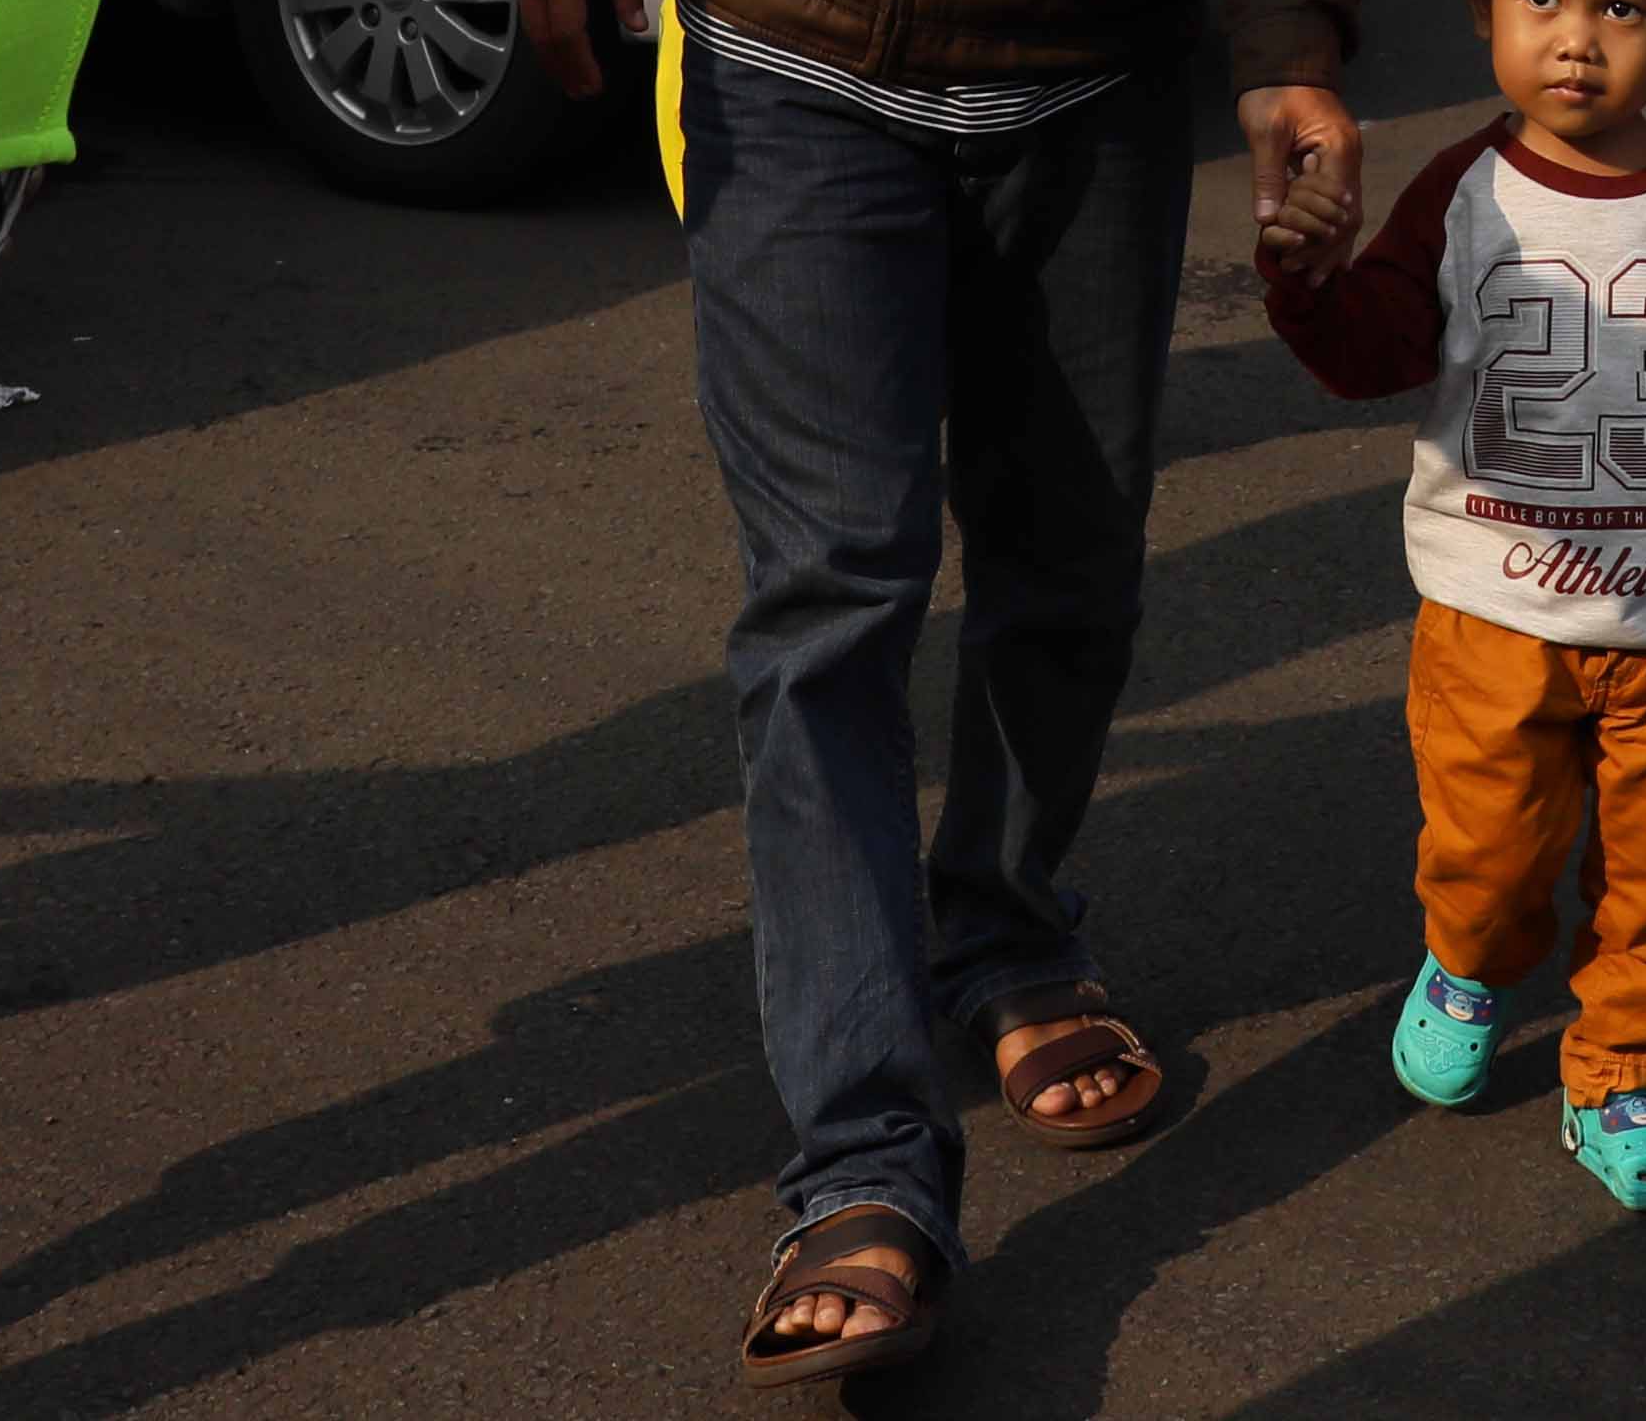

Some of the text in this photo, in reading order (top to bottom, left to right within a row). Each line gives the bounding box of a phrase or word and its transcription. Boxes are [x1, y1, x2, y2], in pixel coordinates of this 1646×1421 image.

[1471, 498, 1528, 522] LITTLE
[1534, 510, 1585, 525] BOYS
[1593, 511, 1613, 525] OF
